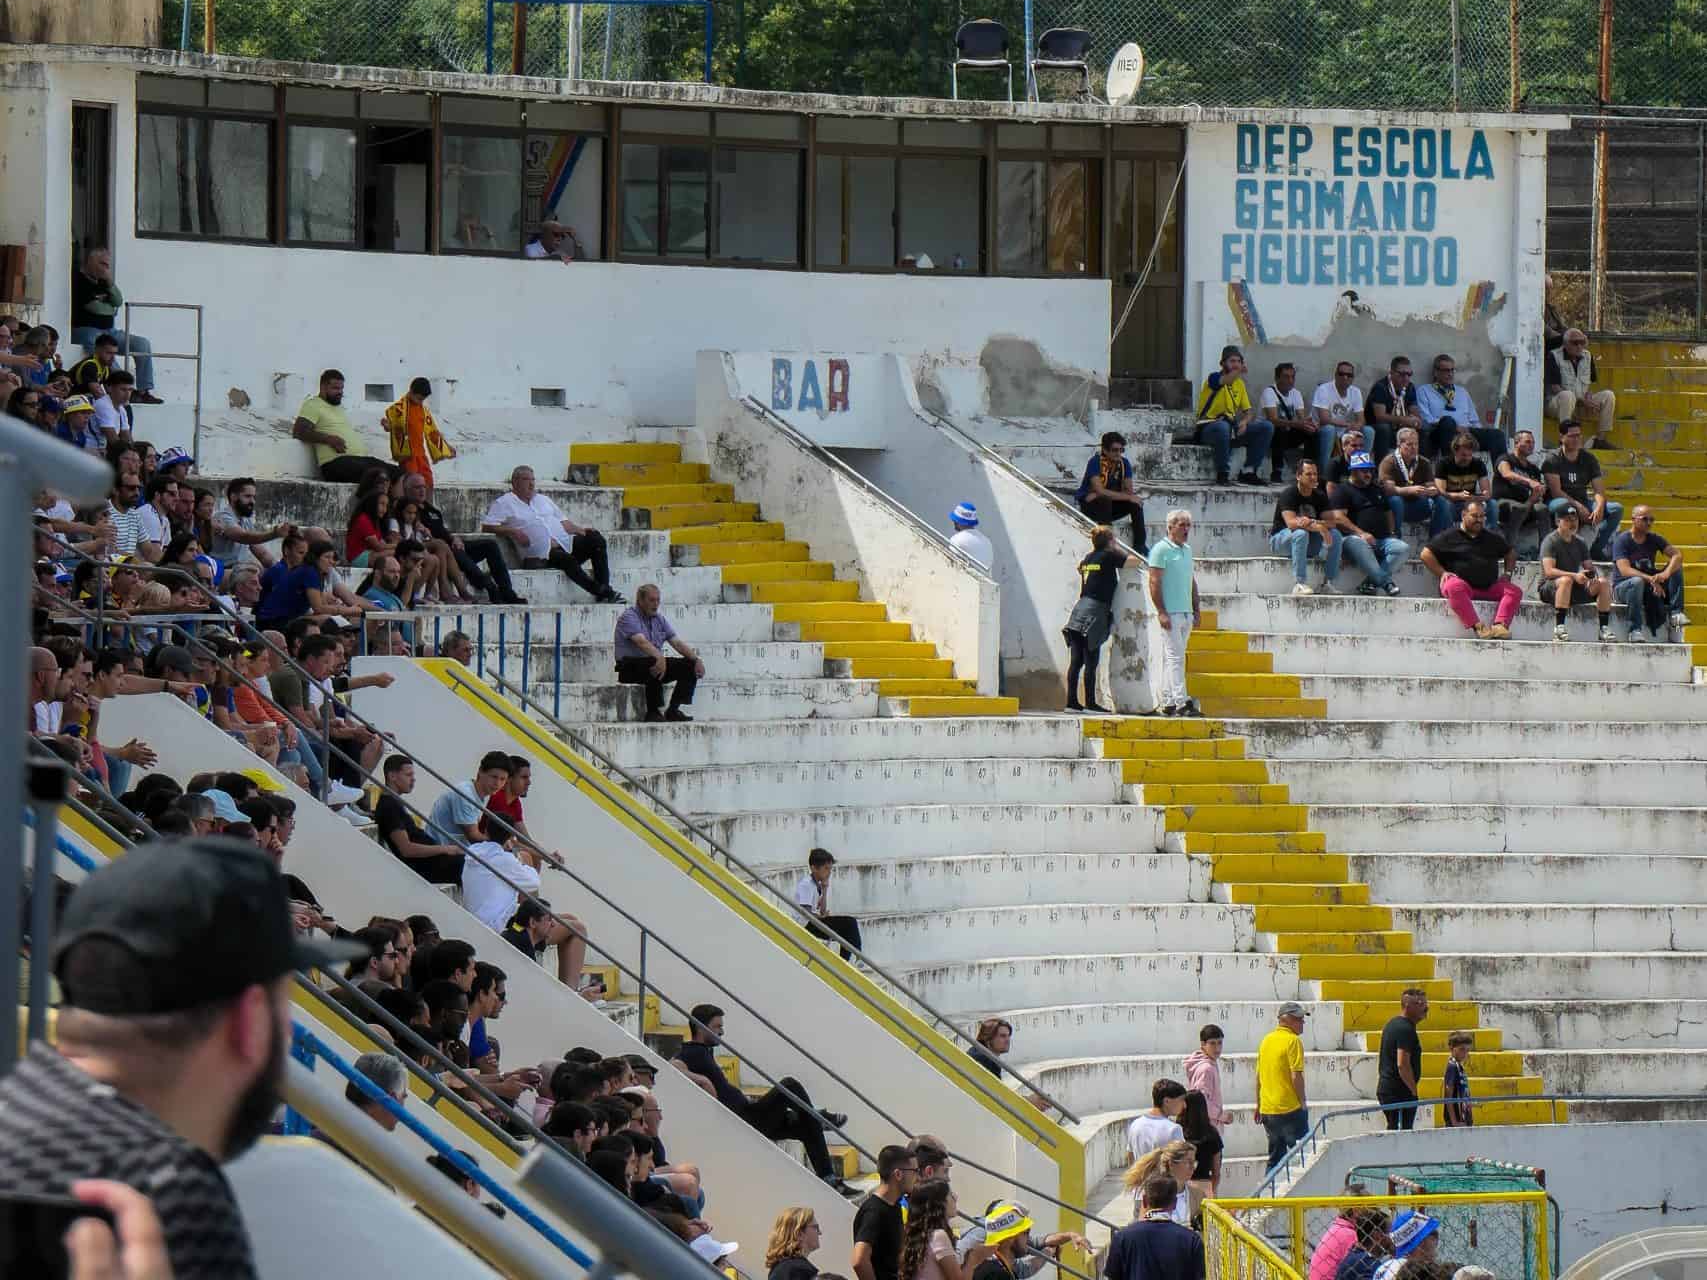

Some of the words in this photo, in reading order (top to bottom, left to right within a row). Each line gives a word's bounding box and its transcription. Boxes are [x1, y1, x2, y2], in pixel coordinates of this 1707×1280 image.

[1332, 127, 1494, 180] ESCOLA
[1235, 178, 1438, 232] GERMANO
[1221, 233, 1458, 286] FIGUEIREDO
[771, 358, 850, 412] BAR
